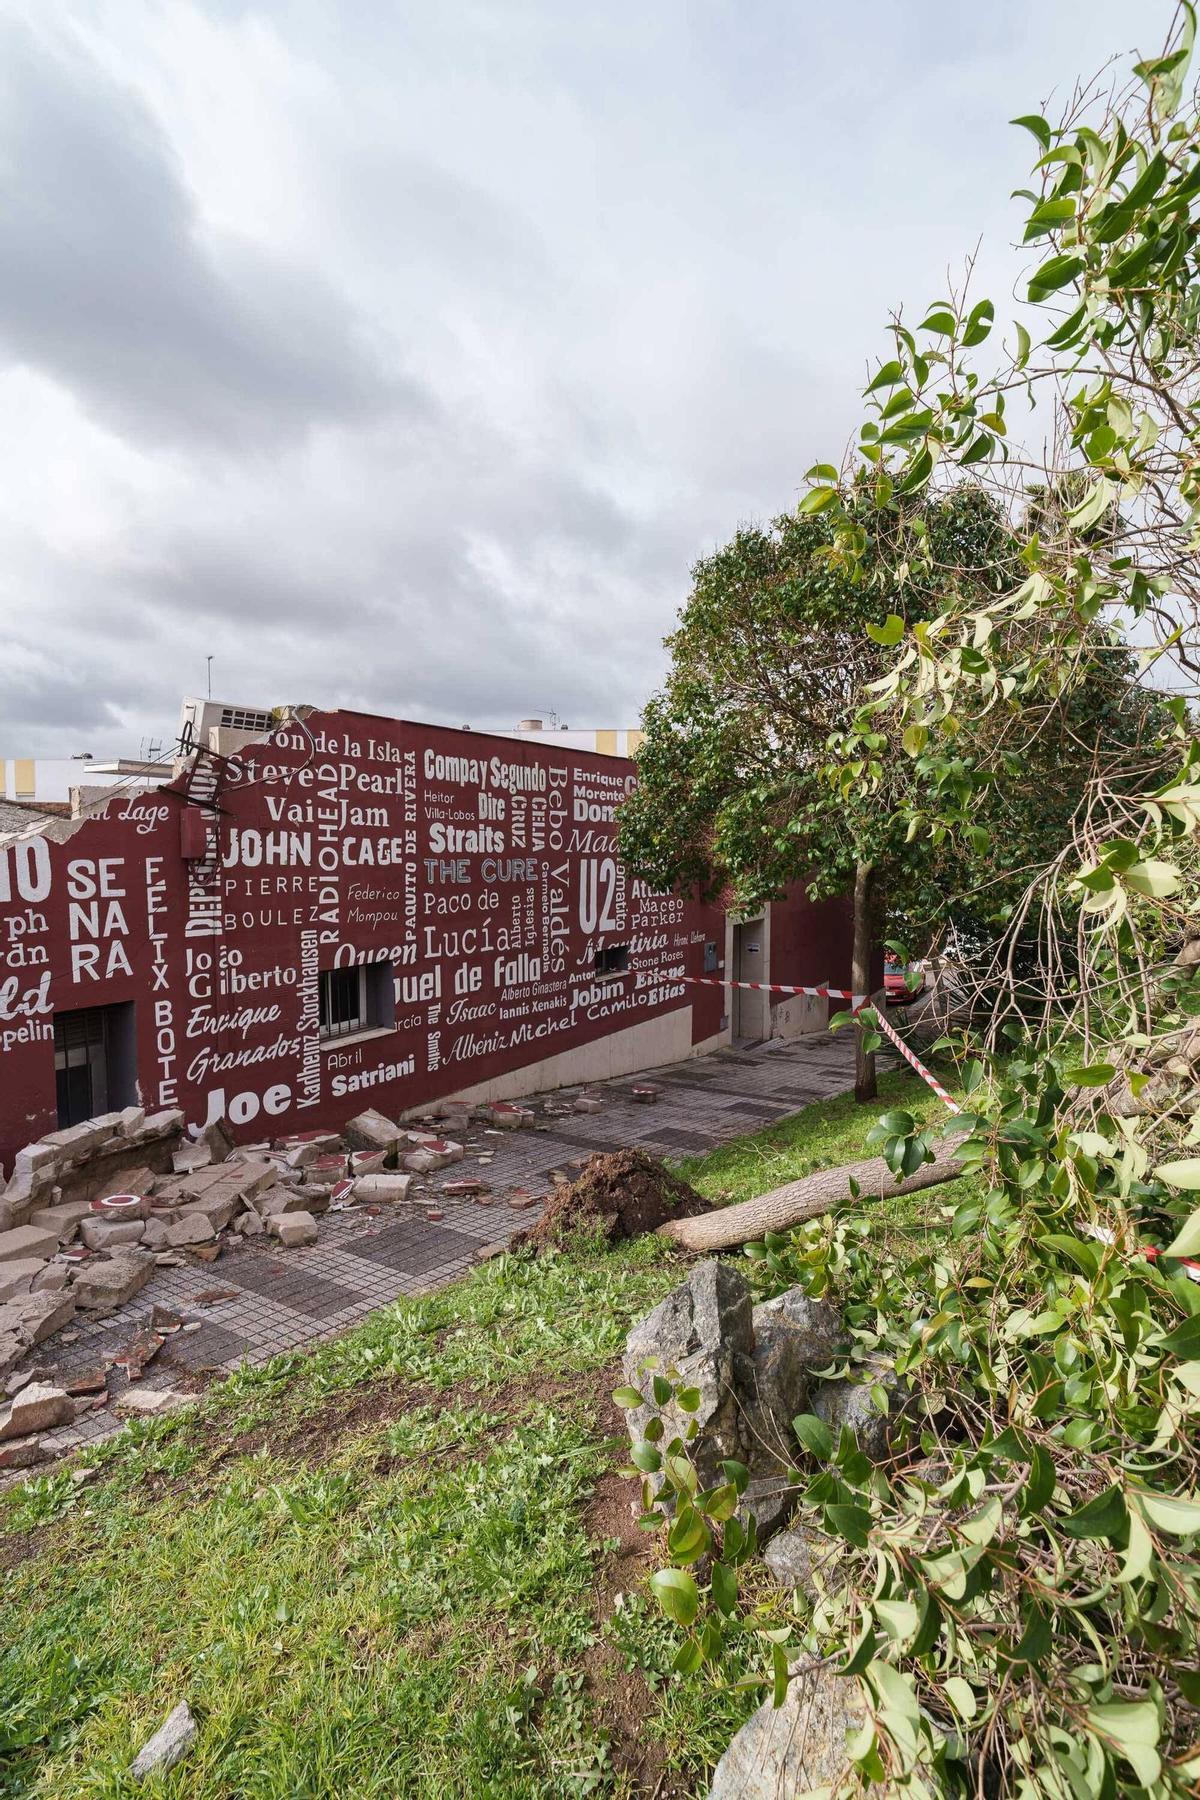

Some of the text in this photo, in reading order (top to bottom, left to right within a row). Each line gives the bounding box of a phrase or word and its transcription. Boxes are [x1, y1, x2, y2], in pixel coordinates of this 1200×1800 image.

[315, 731, 339, 754] de
[343, 735, 361, 758] la
[368, 739, 401, 763] Isla
[226, 755, 314, 787] Steve
[339, 763, 403, 795] Pearl
[424, 748, 546, 794] Compay Segundo
[574, 768, 623, 787] Enrique
[264, 795, 314, 823] Vai
[424, 790, 454, 804] Heitor
[479, 792, 505, 821] Dire
[549, 766, 568, 850] Bebo
[574, 785, 625, 802] Morente
[339, 799, 390, 832] Jam
[424, 807, 475, 820] Villa-Lobos
[511, 795, 527, 848] CRUZ
[532, 797, 547, 852] CELIA
[222, 828, 402, 868] JOHN CAGE
[318, 763, 339, 944] RADIOHEAD
[404, 751, 417, 941] PAQUITO DE RIVERA
[429, 822, 504, 853] Straits
[67, 857, 126, 899] SE
[225, 877, 318, 897] PIERRE
[424, 858, 539, 884] THE CURE
[347, 882, 400, 901] Federico
[424, 888, 499, 914] Paco de
[578, 858, 616, 934] U2
[615, 857, 629, 931] omatito
[640, 898, 684, 914] Maceo
[69, 901, 129, 940] NA
[225, 906, 318, 930] BOULEZ
[347, 907, 398, 930] Mompou
[511, 895, 521, 948] Alberto
[524, 887, 537, 946] Iglesias
[542, 861, 550, 973] Carmelo Bernaola
[550, 858, 569, 973] Valdés
[631, 911, 684, 930] Parker
[424, 917, 510, 959] Lucía
[71, 940, 134, 983] RA
[334, 943, 417, 969] Queen
[632, 956, 659, 970] Stone
[661, 950, 684, 963] Roses
[297, 929, 319, 1031] Stockhausen
[455, 962, 482, 994] de
[501, 980, 567, 1002] Alberto Ginastera
[500, 995, 567, 1020] Iannis Xenakis
[569, 981, 624, 1010] Jobim
[648, 983, 685, 1006] Elias
[186, 1004, 281, 1039] Enrique
[446, 998, 496, 1025] Isaac
[509, 994, 647, 1047] Michel Camilo
[0, 1019, 54, 1051] pelin
[427, 1003, 441, 1072] The Smiths
[442, 1031, 508, 1065] Albéniz
[155, 1000, 179, 1106] BOTE
[186, 1034, 300, 1084] Granados
[327, 1049, 362, 1070] Abril
[331, 1054, 415, 1098] Satriani
[187, 1084, 291, 1138] Joe
